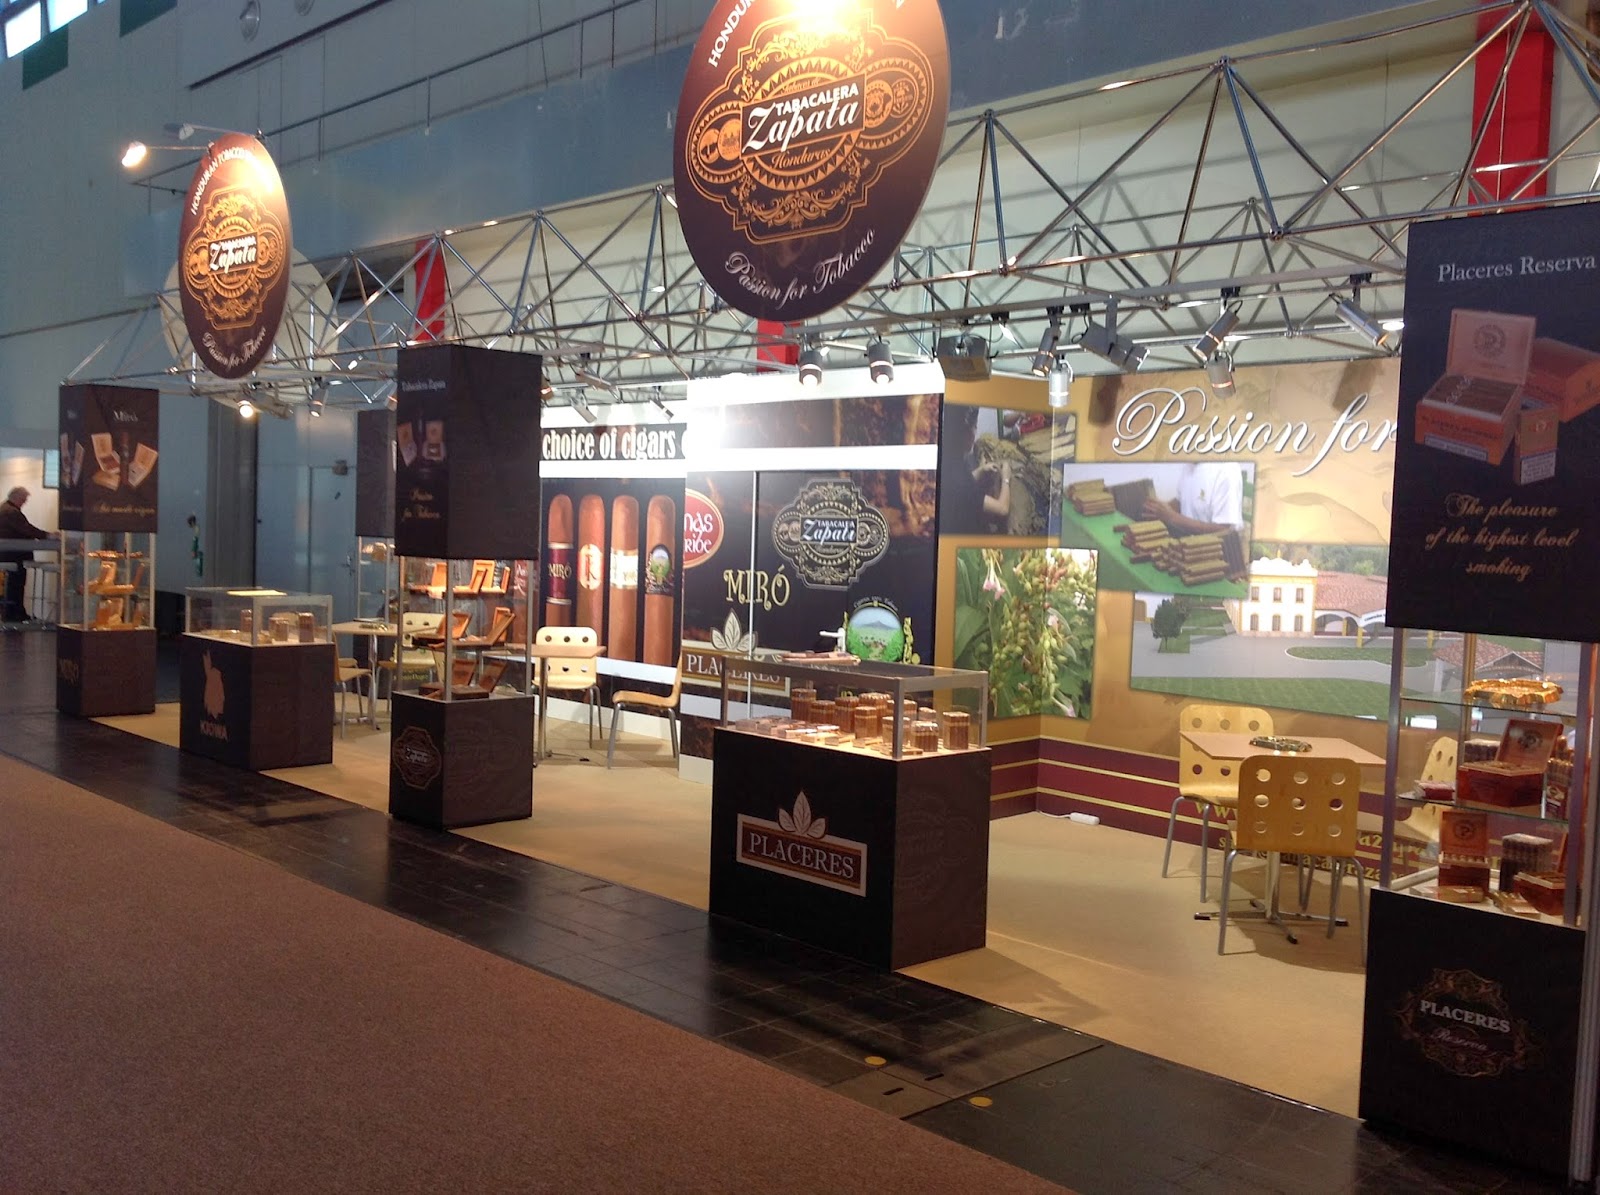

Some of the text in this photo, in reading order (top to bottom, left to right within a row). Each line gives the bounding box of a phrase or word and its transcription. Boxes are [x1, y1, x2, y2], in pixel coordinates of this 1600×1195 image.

[775, 83, 858, 116] TABACALERA
[742, 100, 859, 153] Zapata
[771, 147, 832, 170] Honduras
[725, 227, 876, 311] Passion for Tobacco
[1437, 255, 1597, 283] Placeres Reserva
[542, 428, 595, 460] choice
[599, 428, 617, 459] of
[621, 426, 676, 461] cigars
[1112, 386, 1398, 477] Passion for
[1444, 492, 1559, 524] The pleasure
[1425, 526, 1580, 552] of the highest level
[1465, 556, 1532, 582] smoking
[723, 564, 791, 612] MIRÓ
[749, 832, 855, 880] PLACERES
[1419, 1000, 1511, 1033] PLACERES
[1429, 1026, 1489, 1051] Reserva
